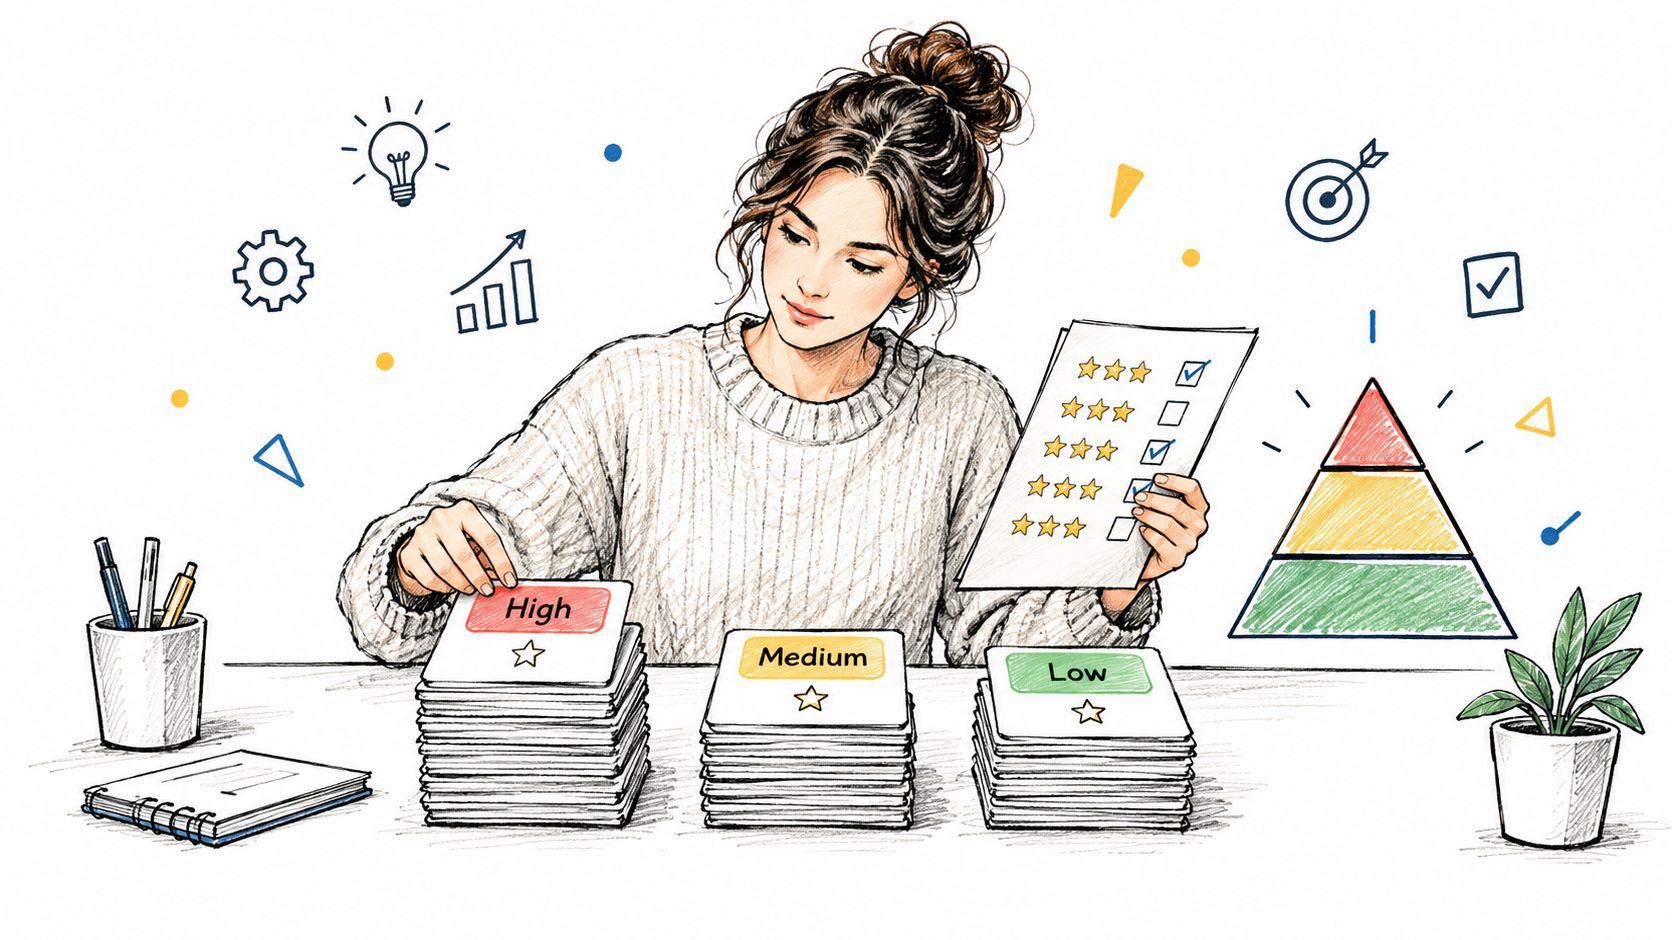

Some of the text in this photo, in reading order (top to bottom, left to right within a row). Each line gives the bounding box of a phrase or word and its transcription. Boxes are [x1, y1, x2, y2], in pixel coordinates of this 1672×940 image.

[505, 596, 572, 625] High
[758, 646, 868, 667] Medium
[1048, 662, 1107, 683] Low
